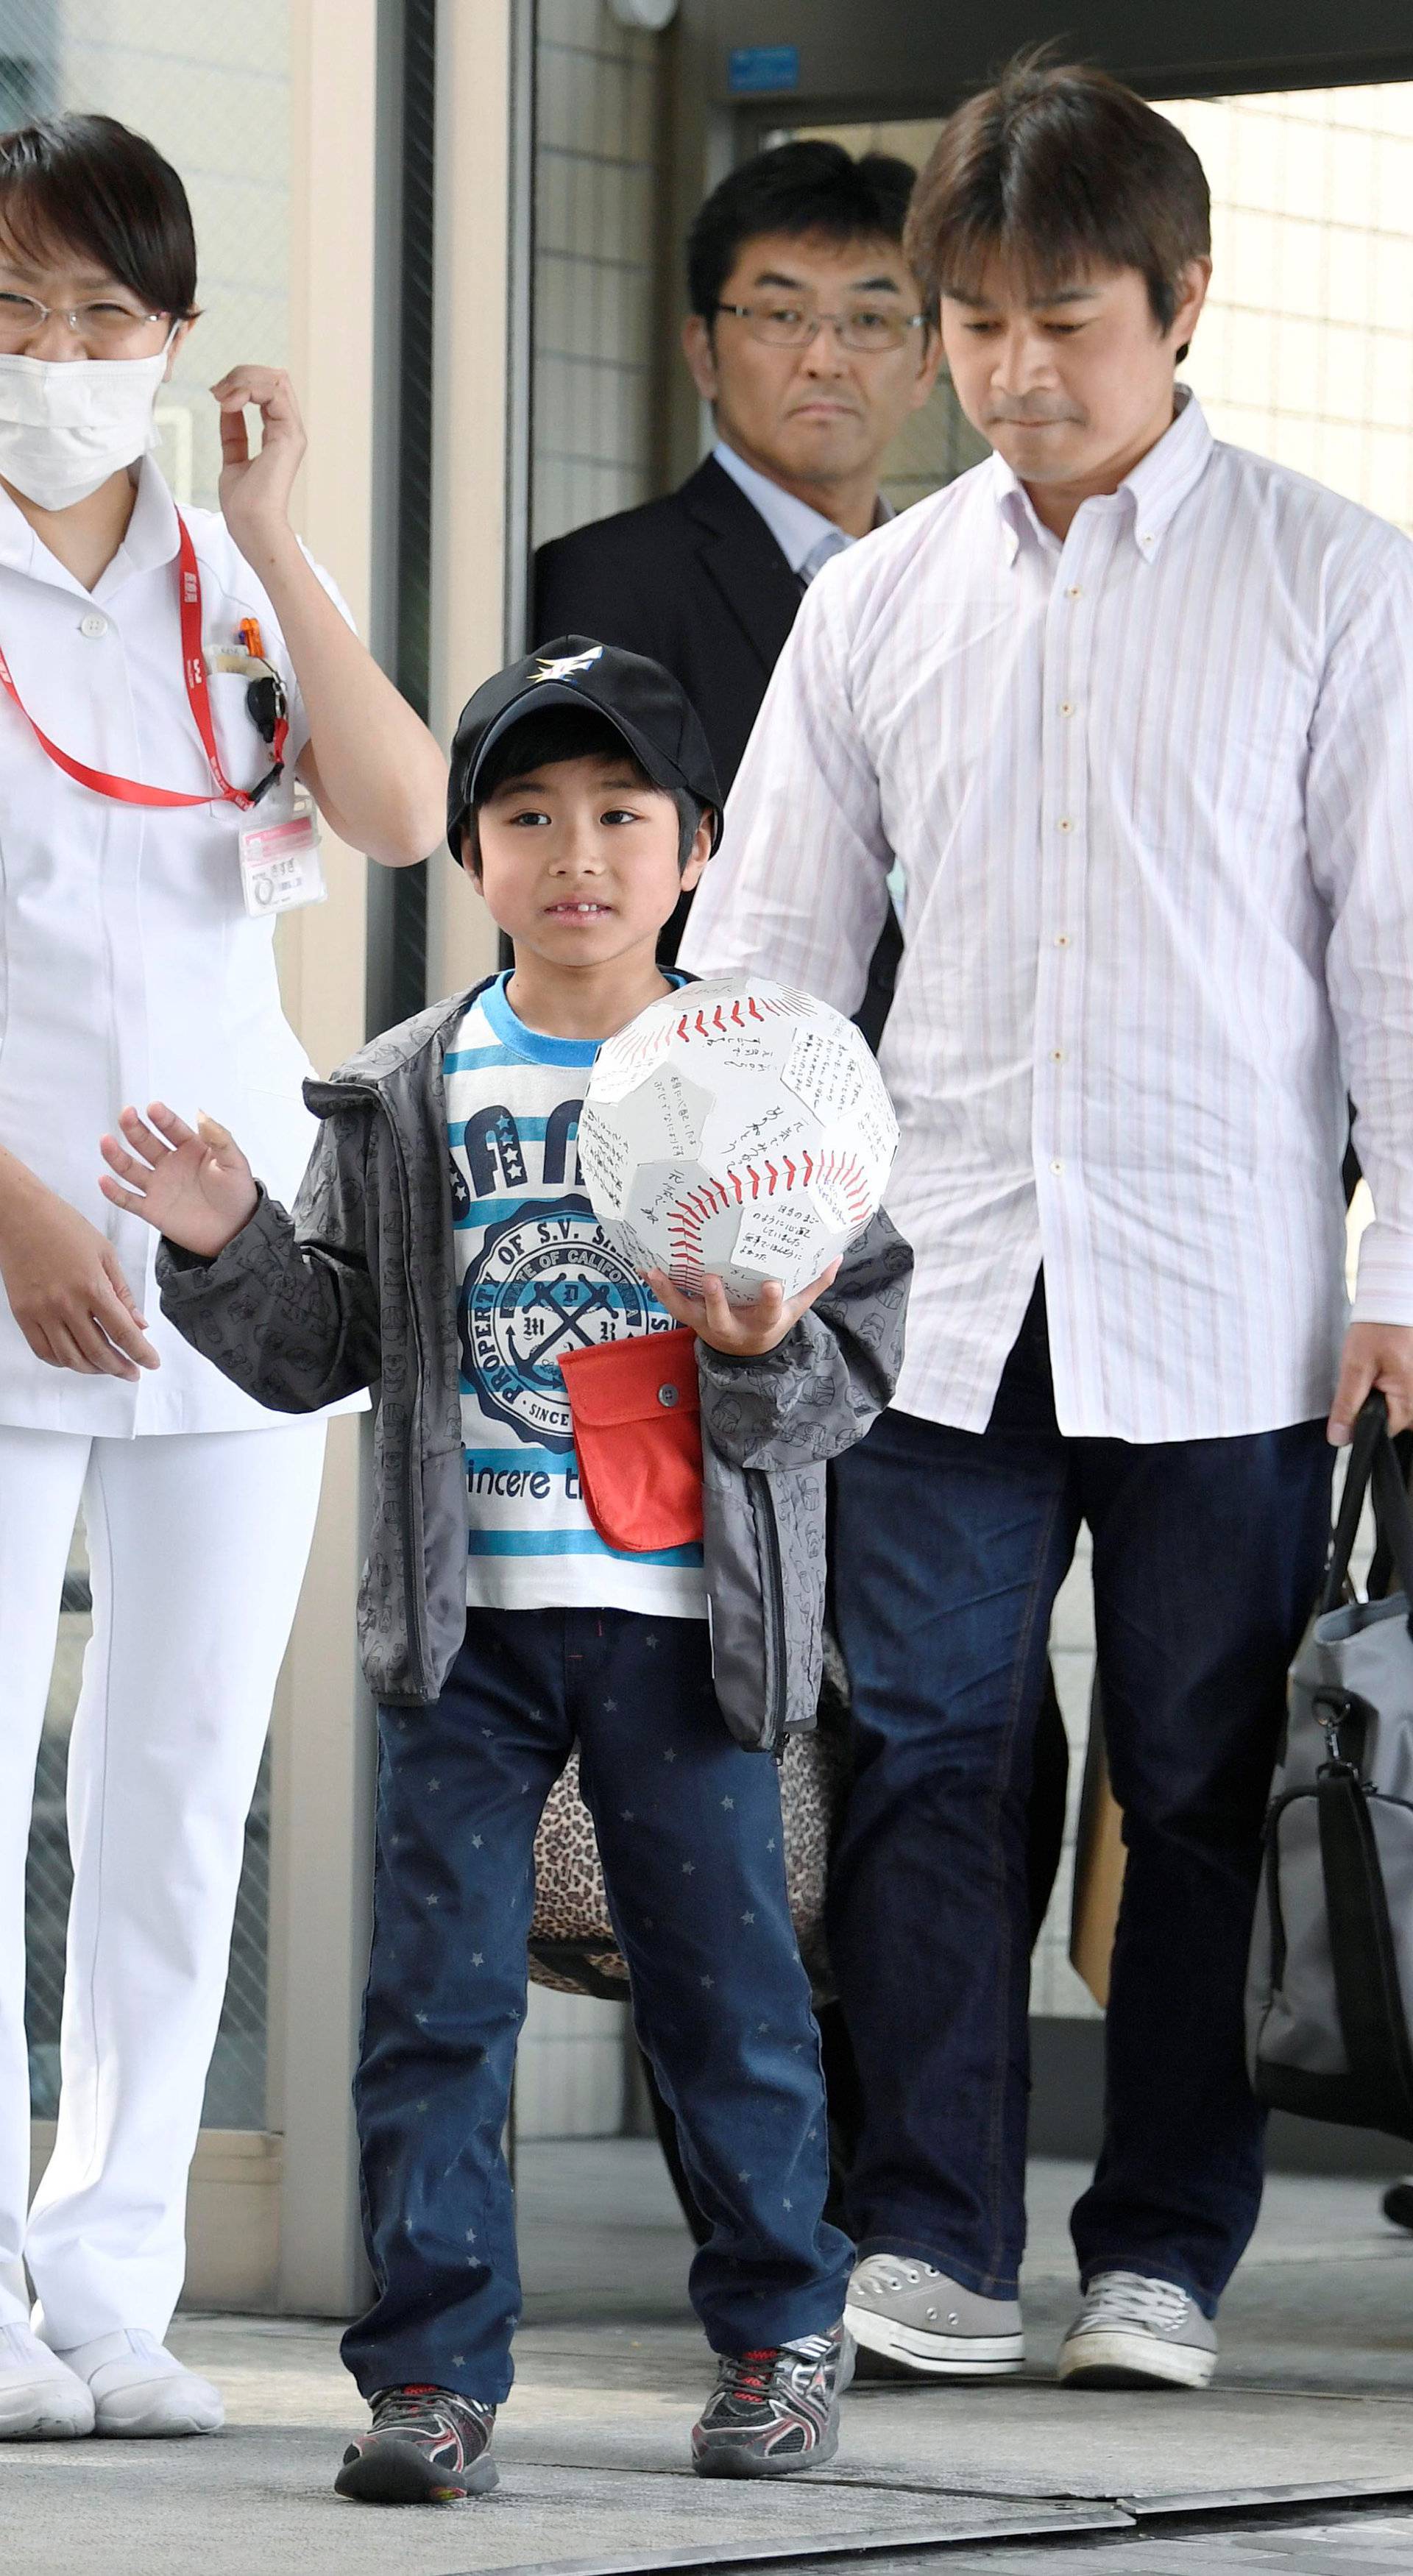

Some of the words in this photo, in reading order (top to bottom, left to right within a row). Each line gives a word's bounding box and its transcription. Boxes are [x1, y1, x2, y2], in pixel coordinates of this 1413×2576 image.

[537, 1218, 579, 1243] S.V.
[497, 1234, 525, 1265] OF
[503, 1264, 537, 1312] STATE
[539, 1250, 560, 1268] OF
[567, 1250, 639, 1318] CALIFORNIA
[474, 1271, 524, 1404] PROPERTY
[528, 1404, 570, 1427] SINCE
[467, 1459, 550, 1499] incere
